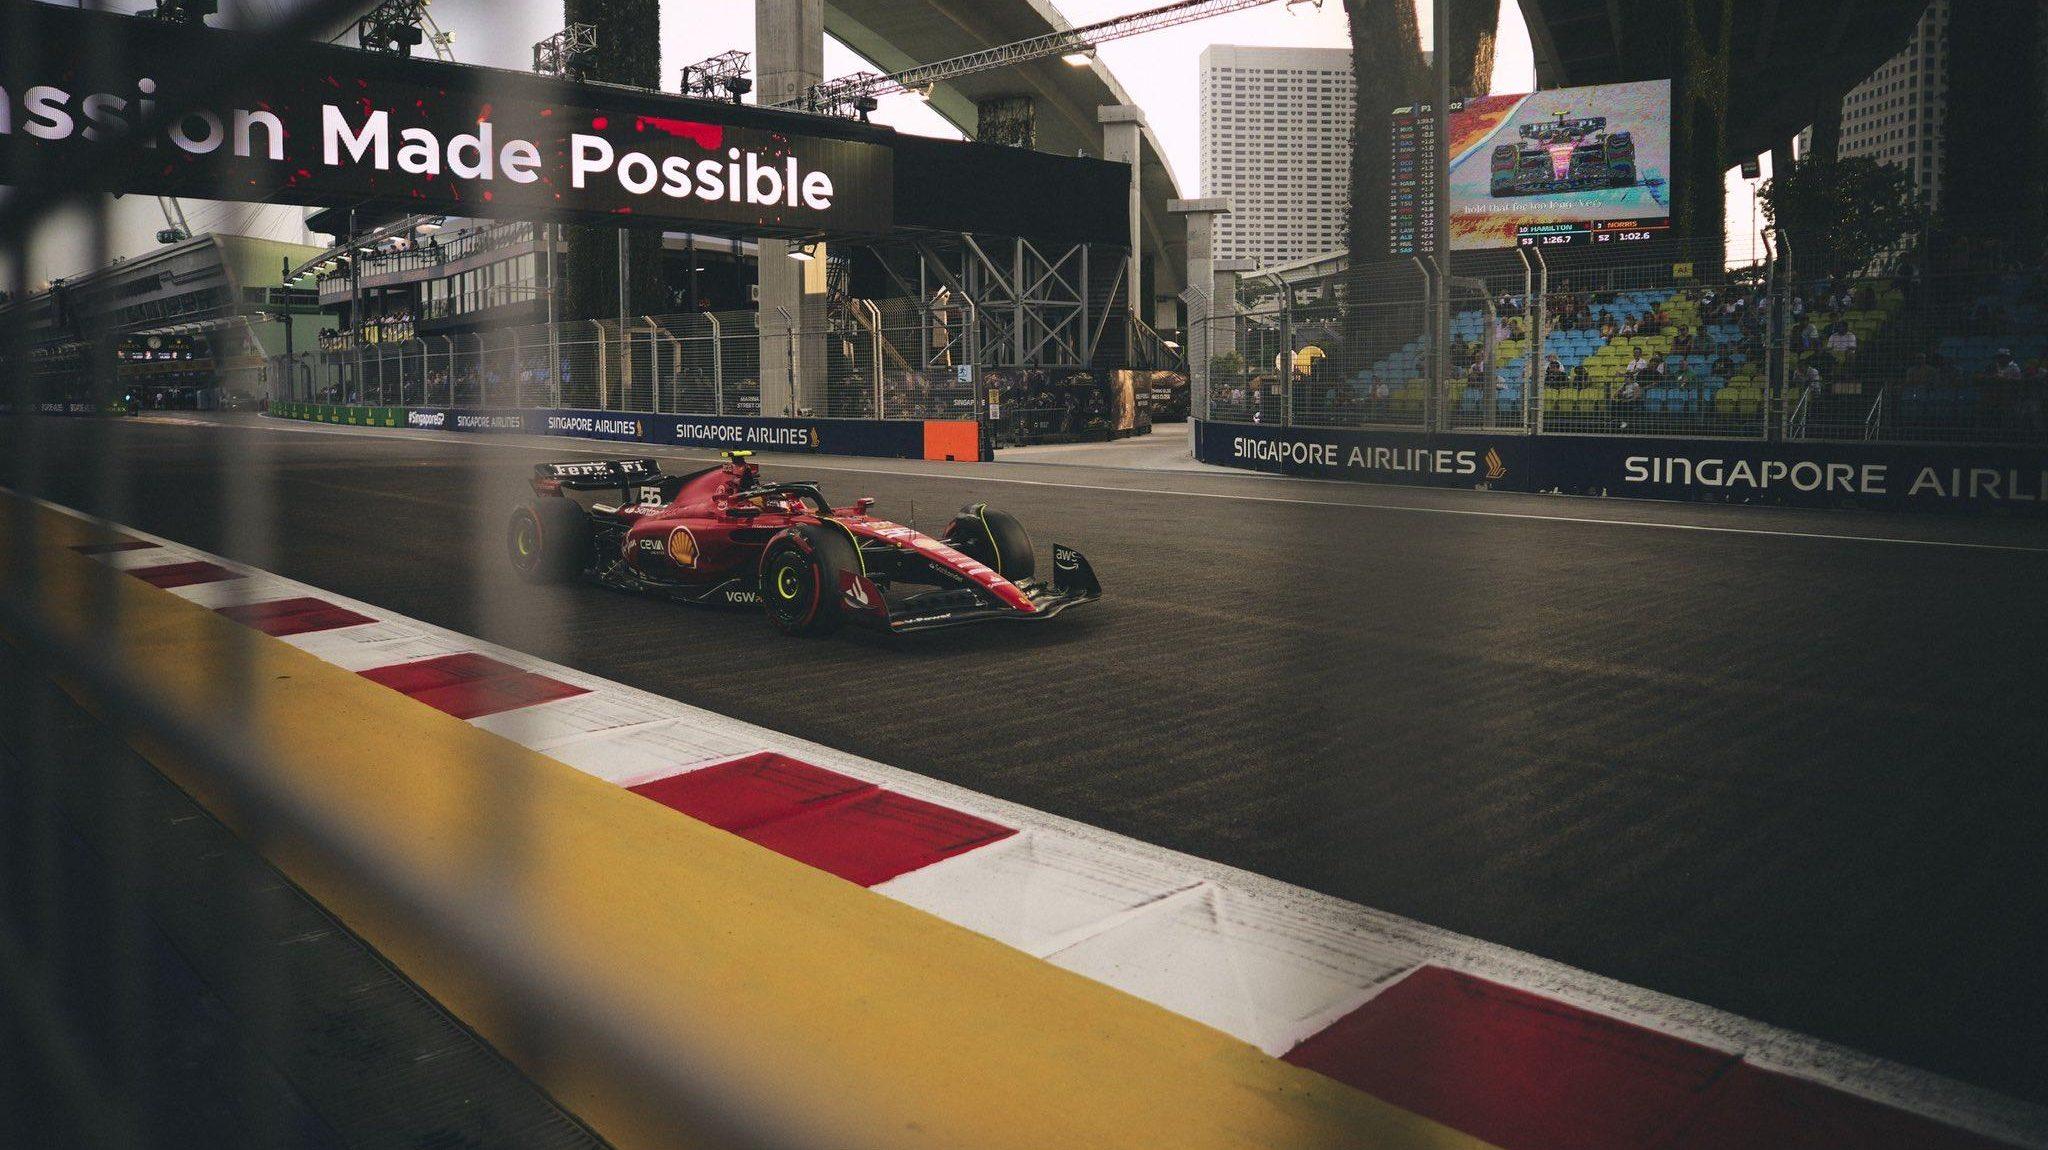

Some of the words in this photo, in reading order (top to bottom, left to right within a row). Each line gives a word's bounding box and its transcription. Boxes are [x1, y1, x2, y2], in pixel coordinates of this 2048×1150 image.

[0, 77, 284, 160] ssion
[322, 104, 542, 184] Made
[571, 132, 834, 211] Possible
[1530, 223, 1573, 233] HAMILTON
[1607, 220, 1638, 229] NORRIS
[1543, 235, 1572, 245] 1:26.7
[1619, 231, 1650, 241] 1:02.6
[408, 410, 444, 426] #SingaporeGP
[457, 416, 490, 428] SINGAPORE
[491, 416, 520, 428] AIRLINES
[548, 416, 593, 432] SINGAPORE
[594, 418, 635, 435] AIRLINES
[676, 423, 742, 442] SINGAPORE
[746, 427, 808, 445] AIRLINES
[1233, 436, 1338, 467] SINGAPORE
[1346, 446, 1476, 475] AIRLINES
[553, 461, 645, 477] Ferrri
[1624, 455, 1889, 494] SINGAPORE
[1907, 466, 2048, 501] AIRLI
[640, 486, 662, 508] 55
[1056, 548, 1077, 563] aws
[725, 591, 755, 603] VGW
